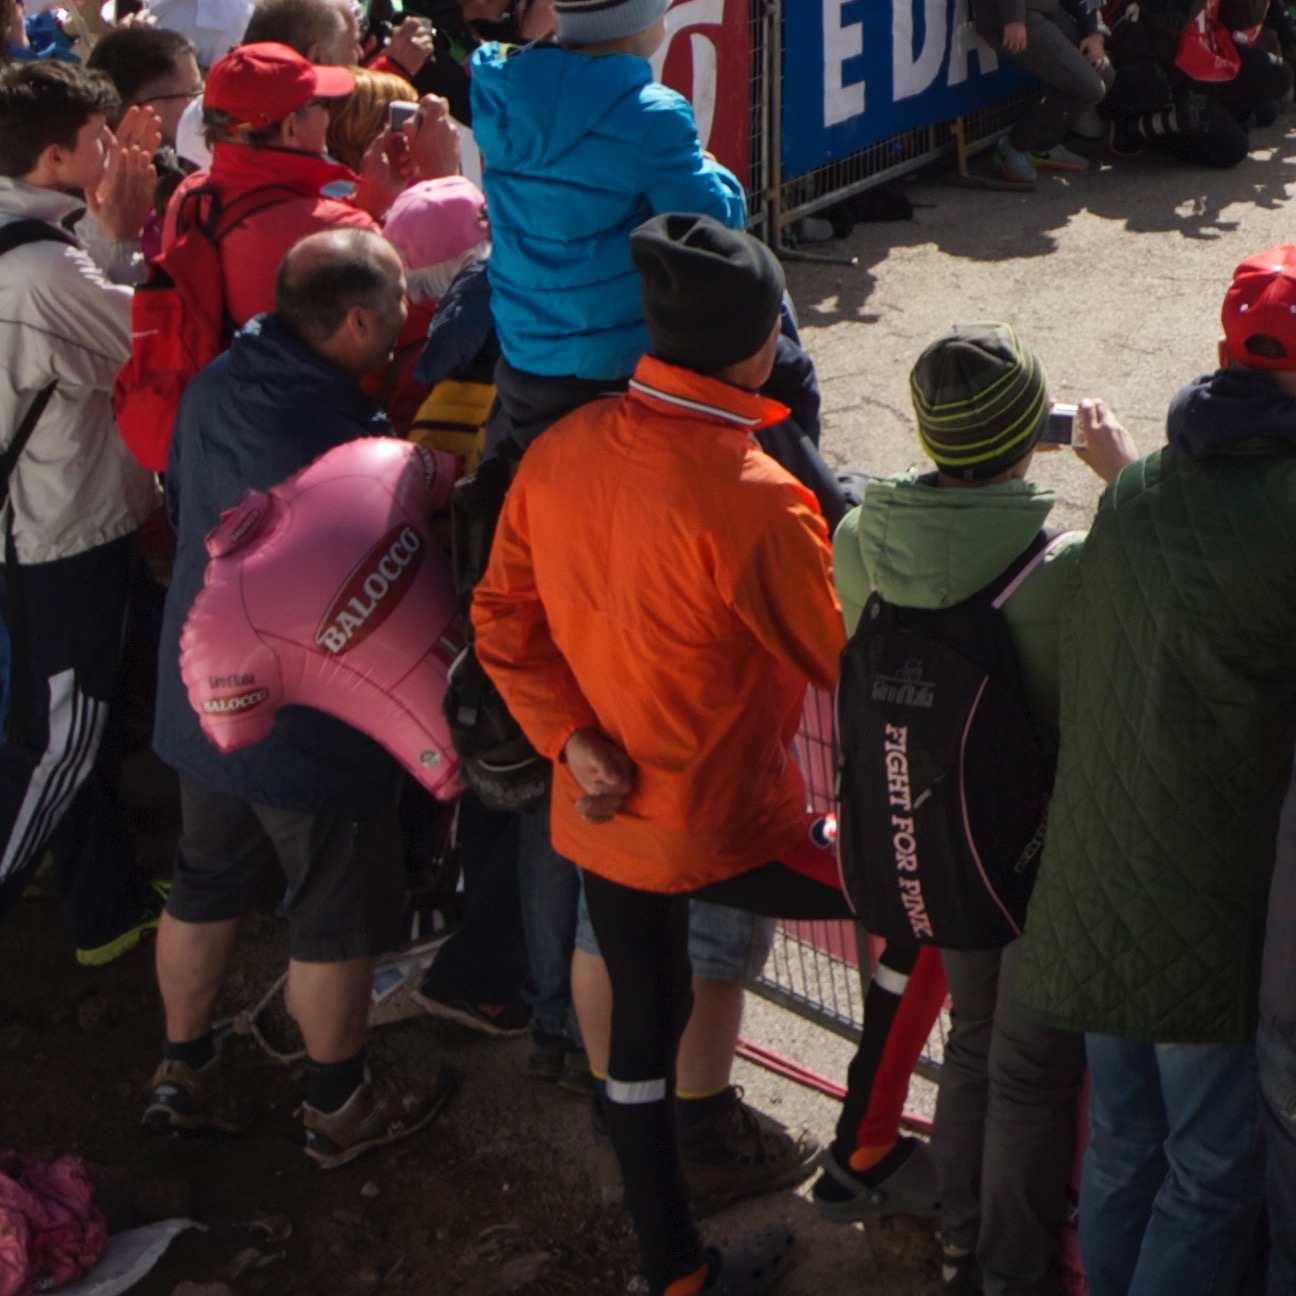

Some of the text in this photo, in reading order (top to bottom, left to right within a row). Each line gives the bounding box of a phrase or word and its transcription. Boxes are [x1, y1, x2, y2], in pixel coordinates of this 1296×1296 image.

[318, 526, 421, 654] BALOCCO
[885, 723, 912, 811] FIGHT
[891, 814, 918, 872] FOR
